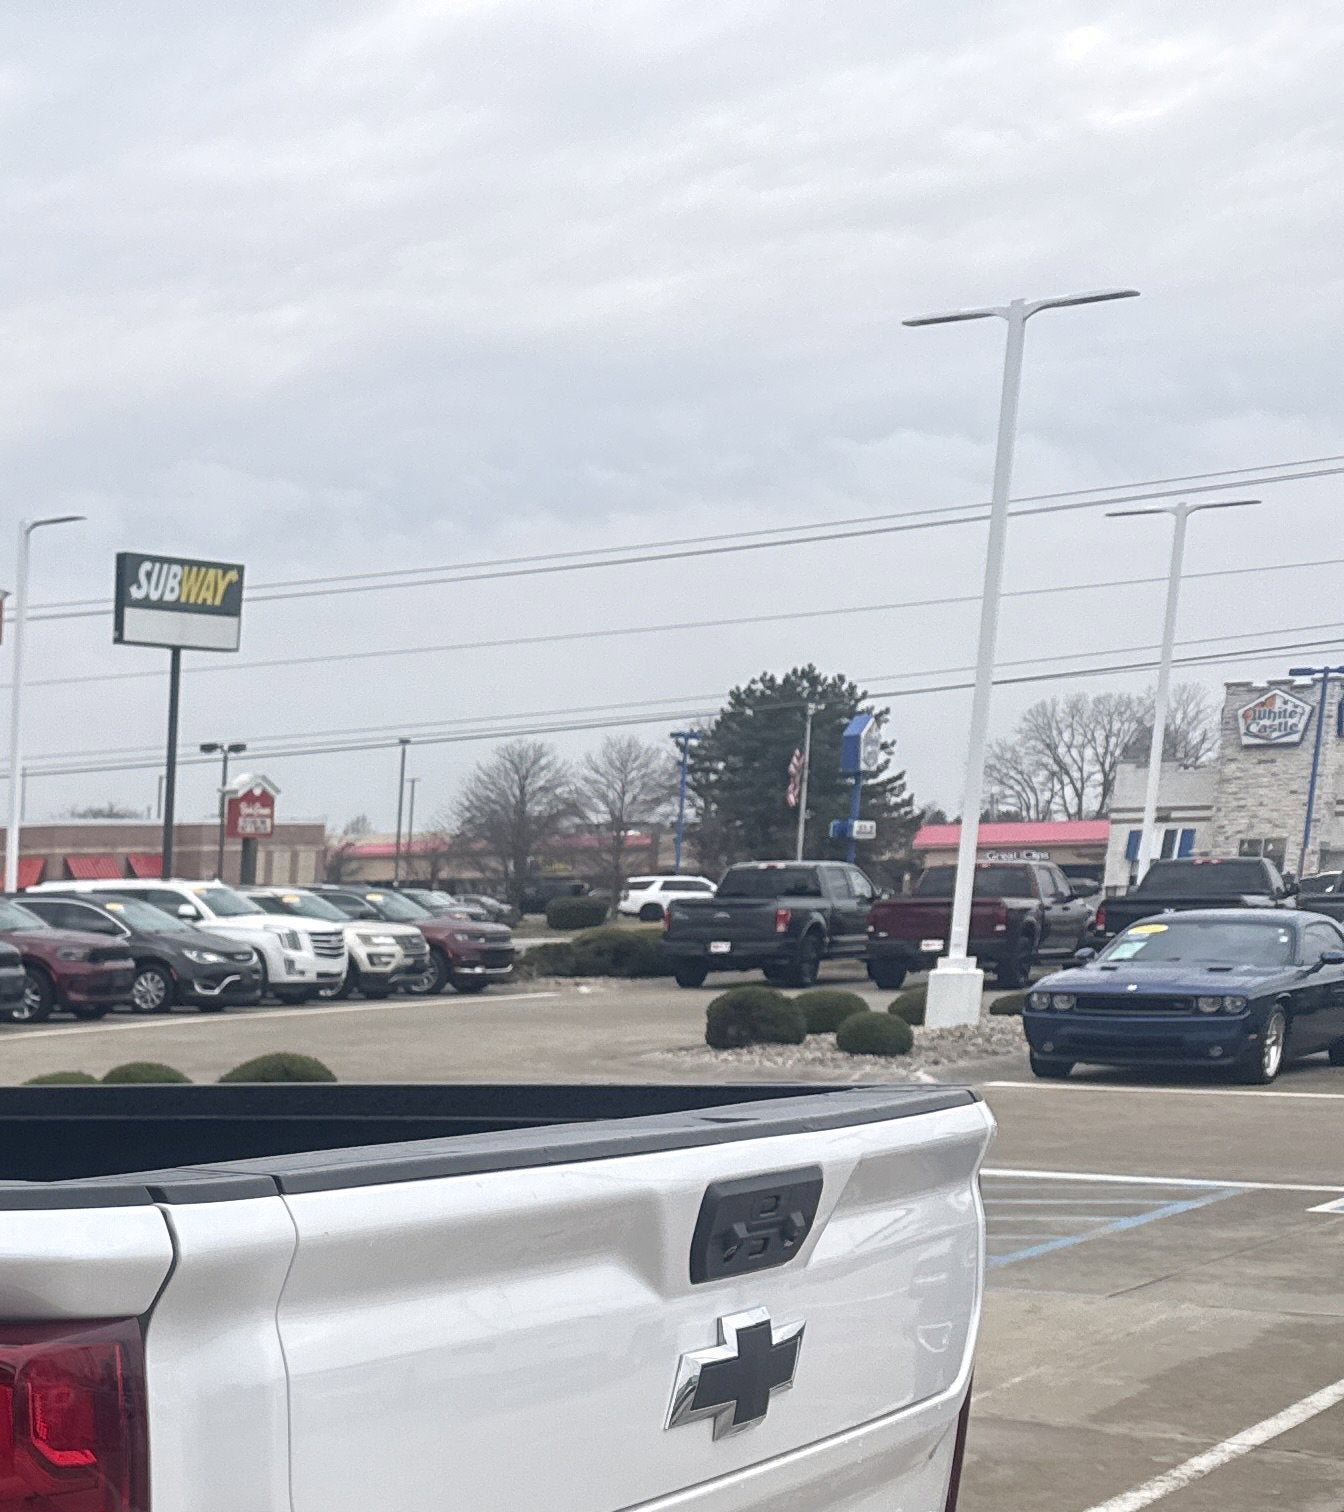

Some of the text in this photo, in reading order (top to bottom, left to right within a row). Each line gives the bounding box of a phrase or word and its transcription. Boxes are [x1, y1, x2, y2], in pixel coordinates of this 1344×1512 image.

[129, 560, 239, 607] SUBWAY
[1252, 706, 1299, 722] White
[1246, 720, 1300, 735] Castle
